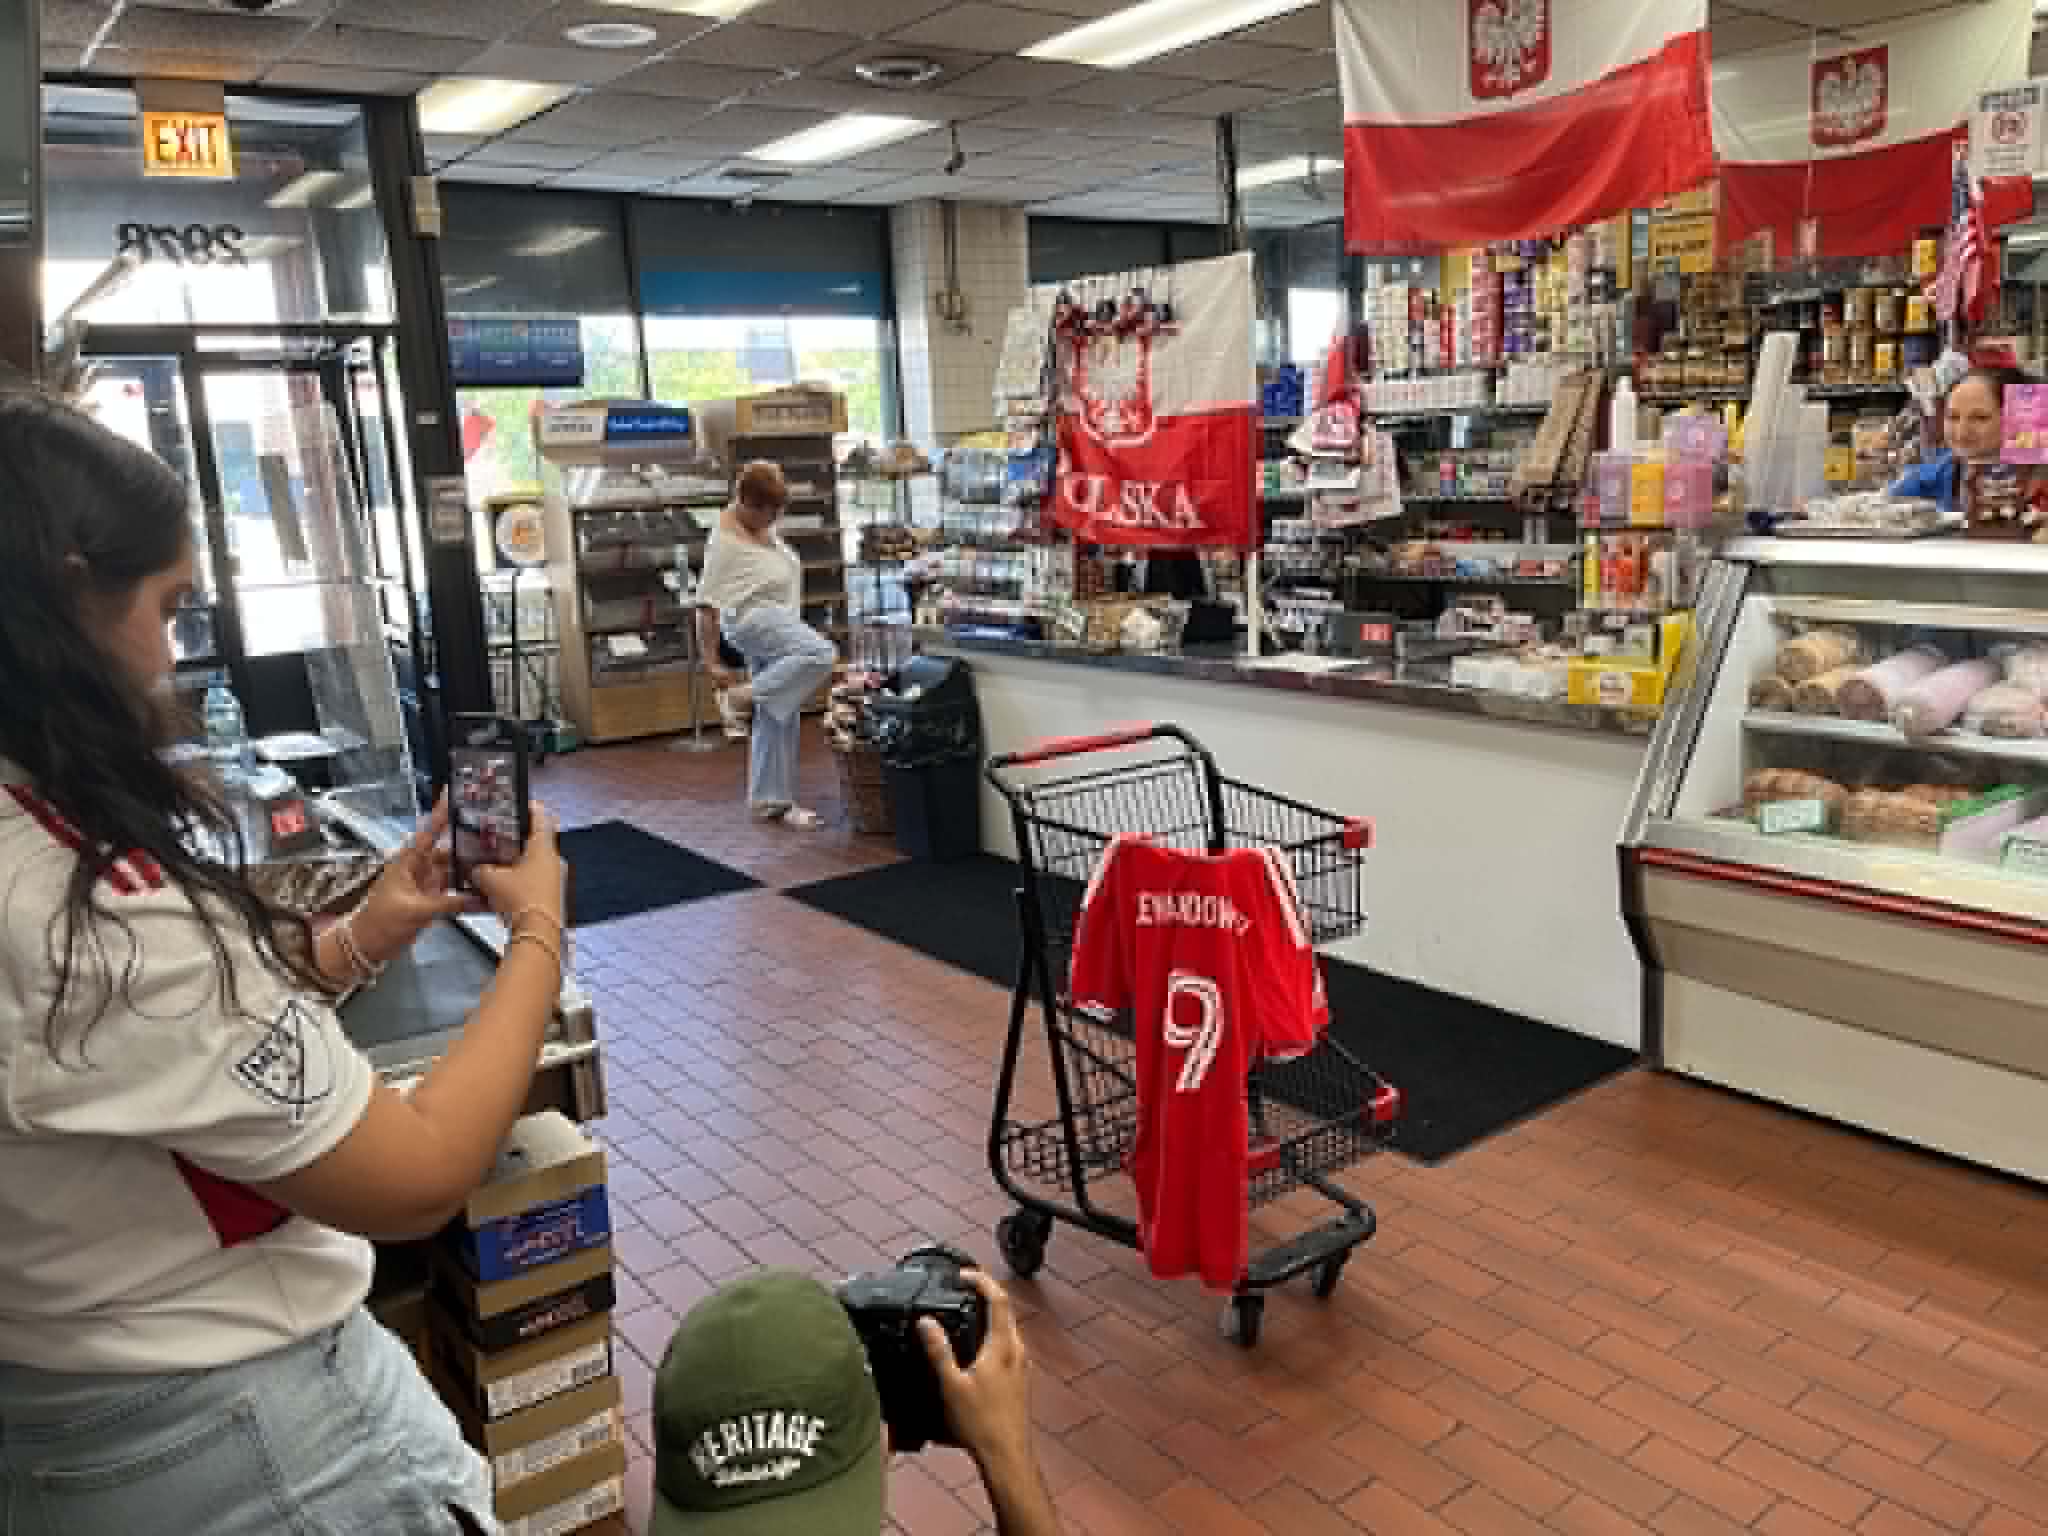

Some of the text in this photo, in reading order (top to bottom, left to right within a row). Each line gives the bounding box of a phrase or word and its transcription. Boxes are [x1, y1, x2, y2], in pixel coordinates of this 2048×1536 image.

[155, 121, 218, 165] EXIT
[1164, 970, 1222, 1092] 9
[689, 1411, 825, 1476] HERITAGE
